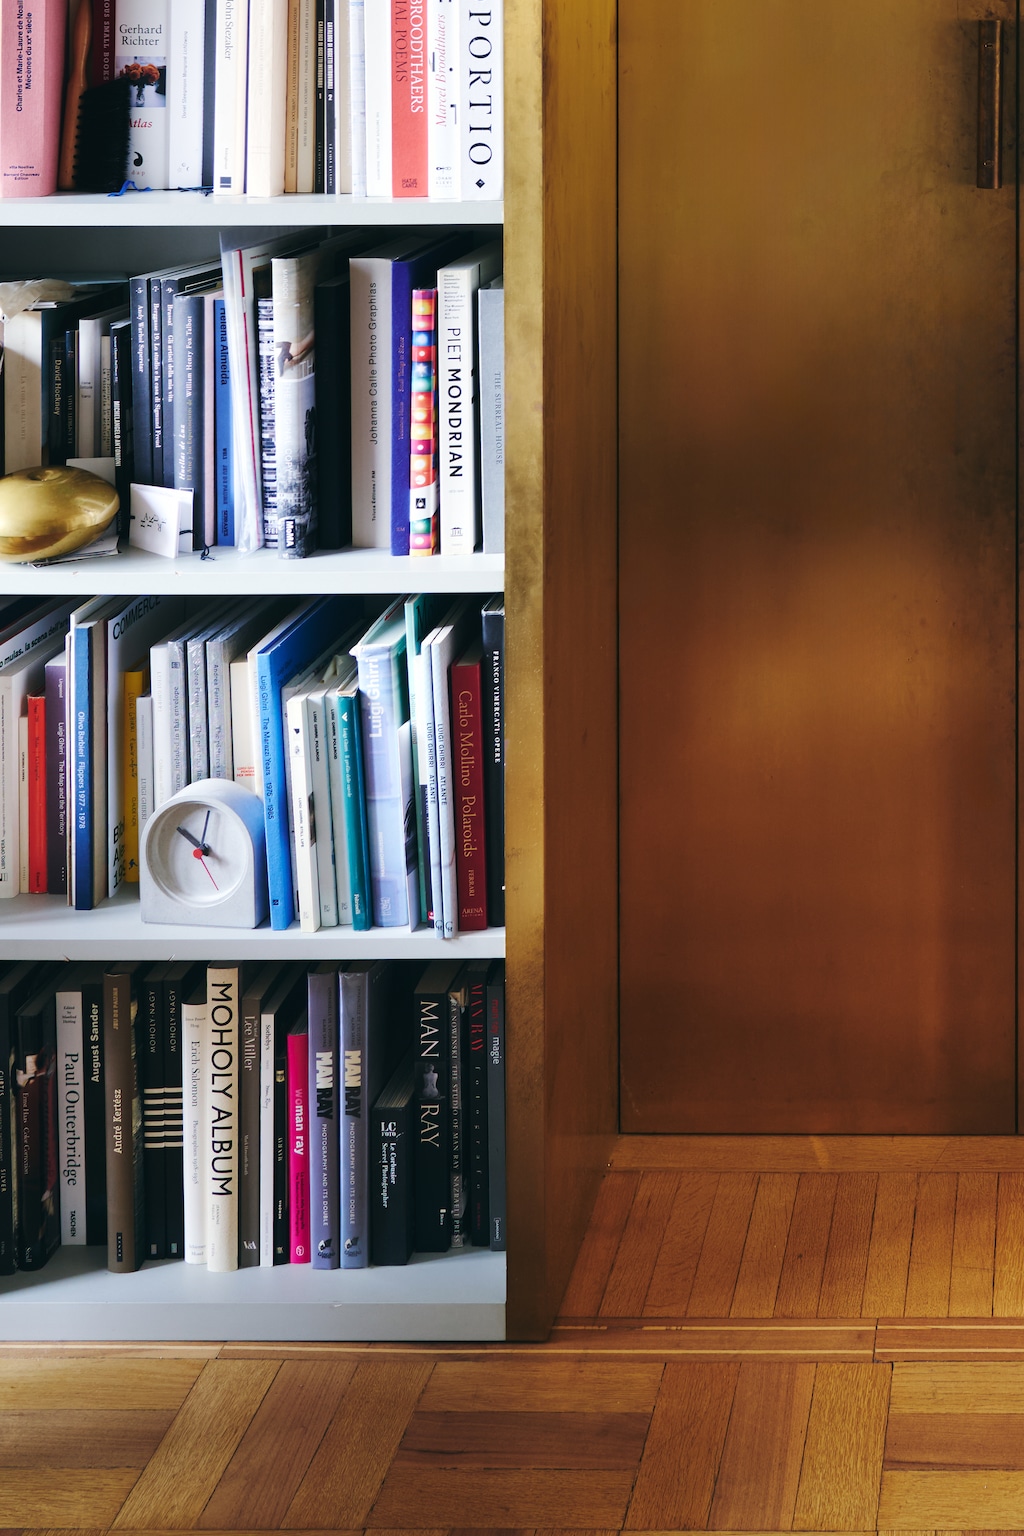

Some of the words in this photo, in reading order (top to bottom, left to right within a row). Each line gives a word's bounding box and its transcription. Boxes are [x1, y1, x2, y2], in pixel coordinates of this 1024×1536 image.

[16, 20, 23, 29] de
[119, 24, 162, 34] Gerhard
[121, 36, 159, 46] Richter
[224, 21, 234, 60] Stezaker
[395, 29, 408, 82] POEMS
[368, 283, 378, 330] Graphias
[369, 334, 378, 365] Photo
[447, 328, 461, 362] PIET
[54, 359, 62, 381] David
[220, 344, 229, 385] Almeida
[53, 383, 62, 415] Hockney
[369, 370, 378, 396] Calle
[369, 401, 378, 445] Johanna
[447, 368, 463, 478] MONDRIAN
[285, 520, 295, 547] MoMA
[77, 711, 86, 729] Olivo
[459, 690, 472, 726] Carlo
[77, 731, 86, 757] Barbieri
[459, 732, 474, 786] Mollino
[76, 761, 86, 788] Flippers
[78, 790, 86, 806] 1977
[461, 796, 477, 857] Polaroids
[91, 1003, 99, 1042] Sander
[244, 1015, 255, 1035] Lee
[420, 1000, 440, 1057] MAN
[191, 1041, 201, 1064] Erich
[211, 983, 233, 1099] MOHOLY
[244, 1037, 256, 1071] Miller
[490, 1037, 502, 1064] magie
[64, 1052, 80, 1086] Paul
[90, 1045, 100, 1082] August
[191, 1068, 201, 1107] Salomon
[112, 1089, 122, 1123] Kertész
[294, 1088, 304, 1131] woman
[64, 1090, 81, 1186] Outerbridge
[113, 1125, 122, 1154] André
[420, 1103, 440, 1147] RAY
[211, 1106, 233, 1196] ALBUM
[293, 1136, 304, 1155] ray
